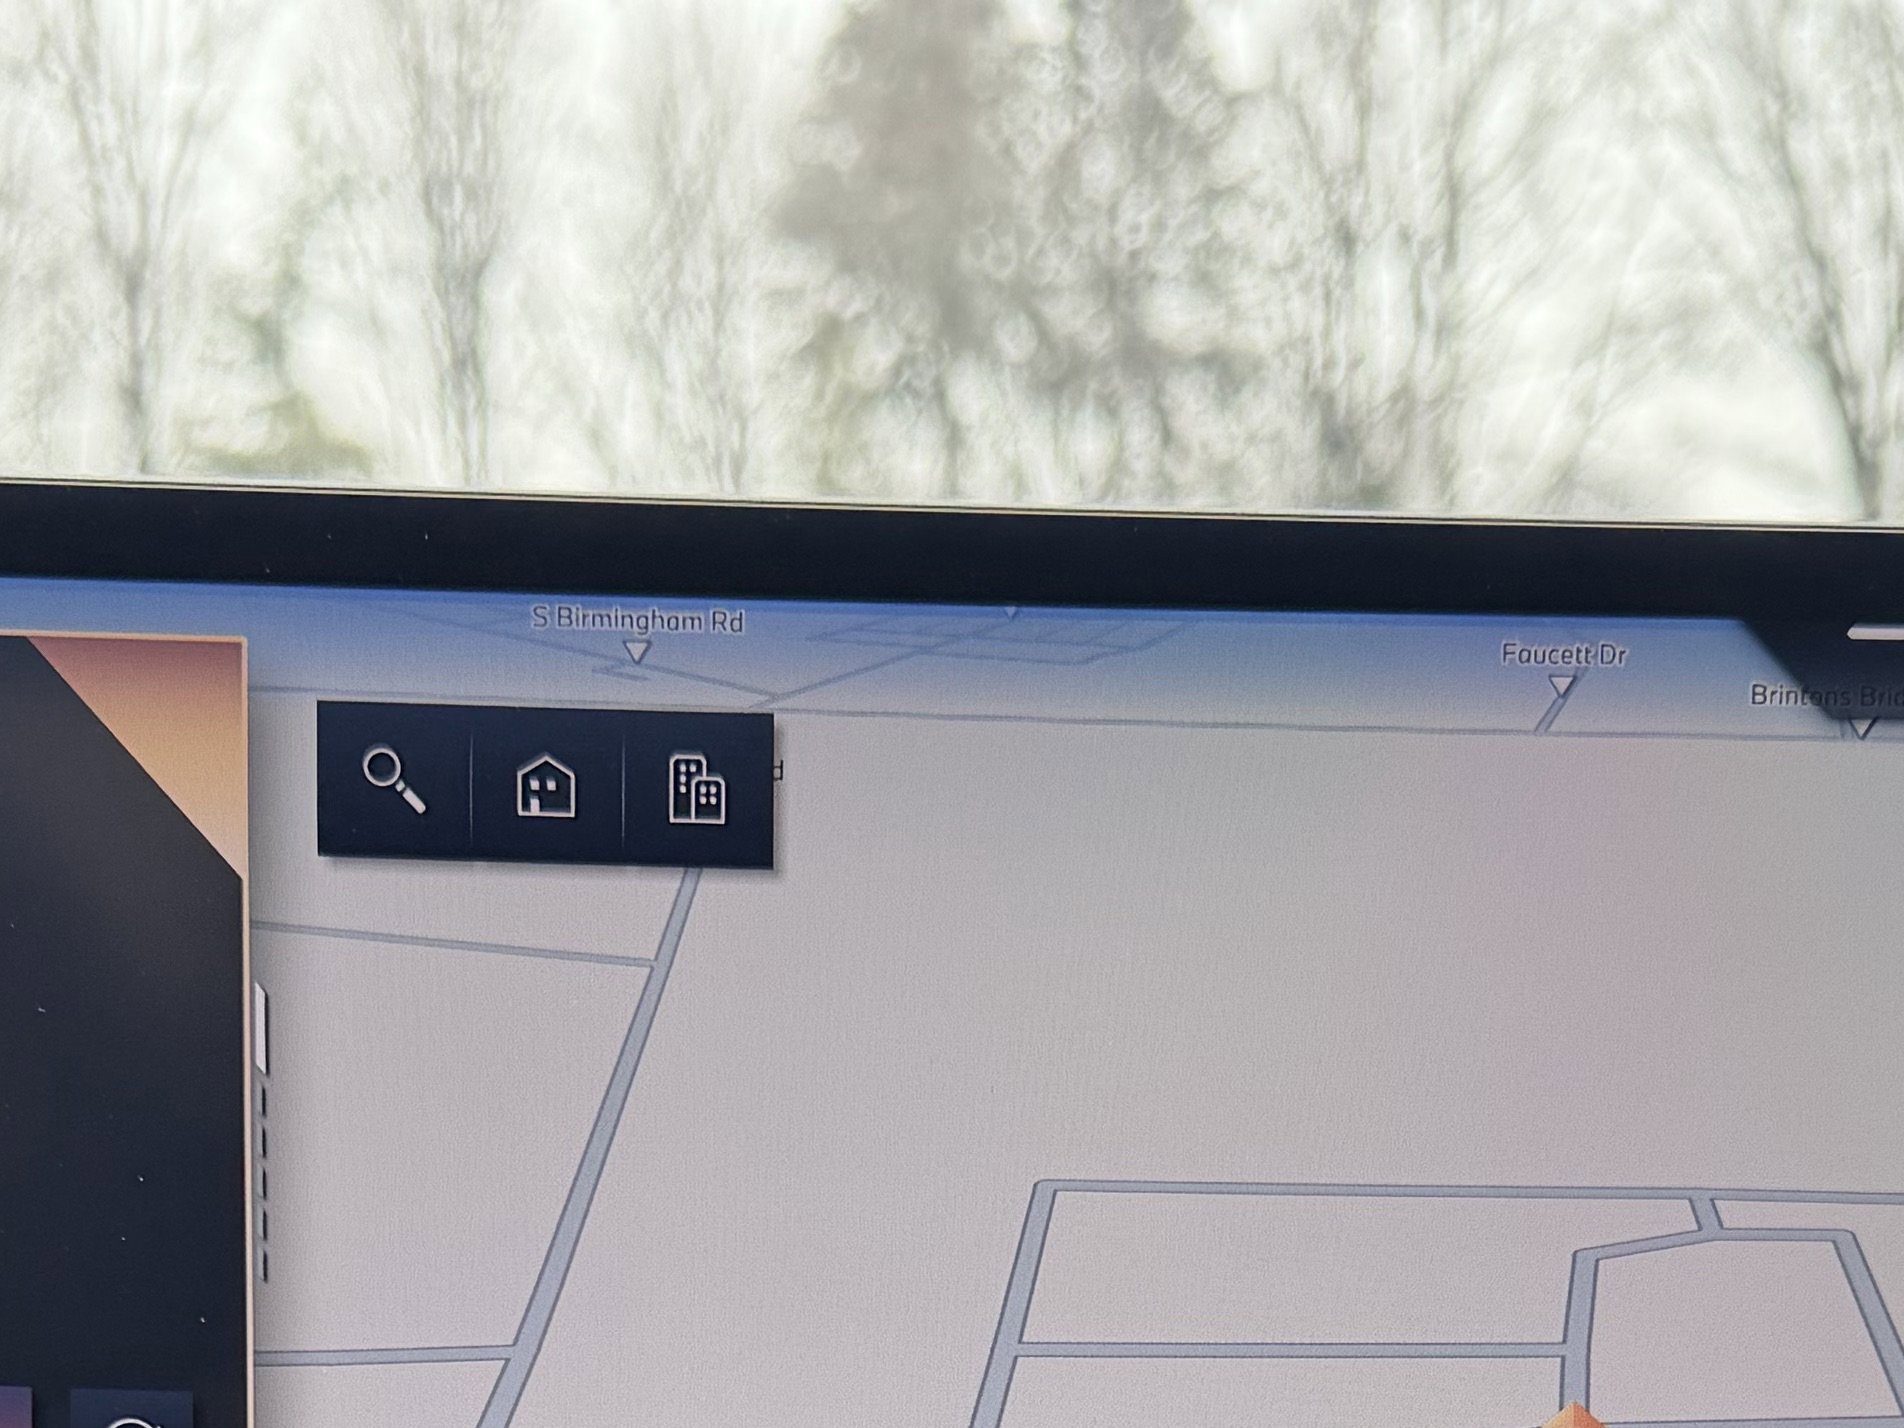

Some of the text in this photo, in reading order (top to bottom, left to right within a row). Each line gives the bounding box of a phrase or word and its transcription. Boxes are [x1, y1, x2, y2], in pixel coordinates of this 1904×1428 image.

[532, 606, 744, 635] S Birmingham Rd
[1502, 643, 1627, 666] Faucett Dr
[1751, 684, 1851, 707] Brintons
